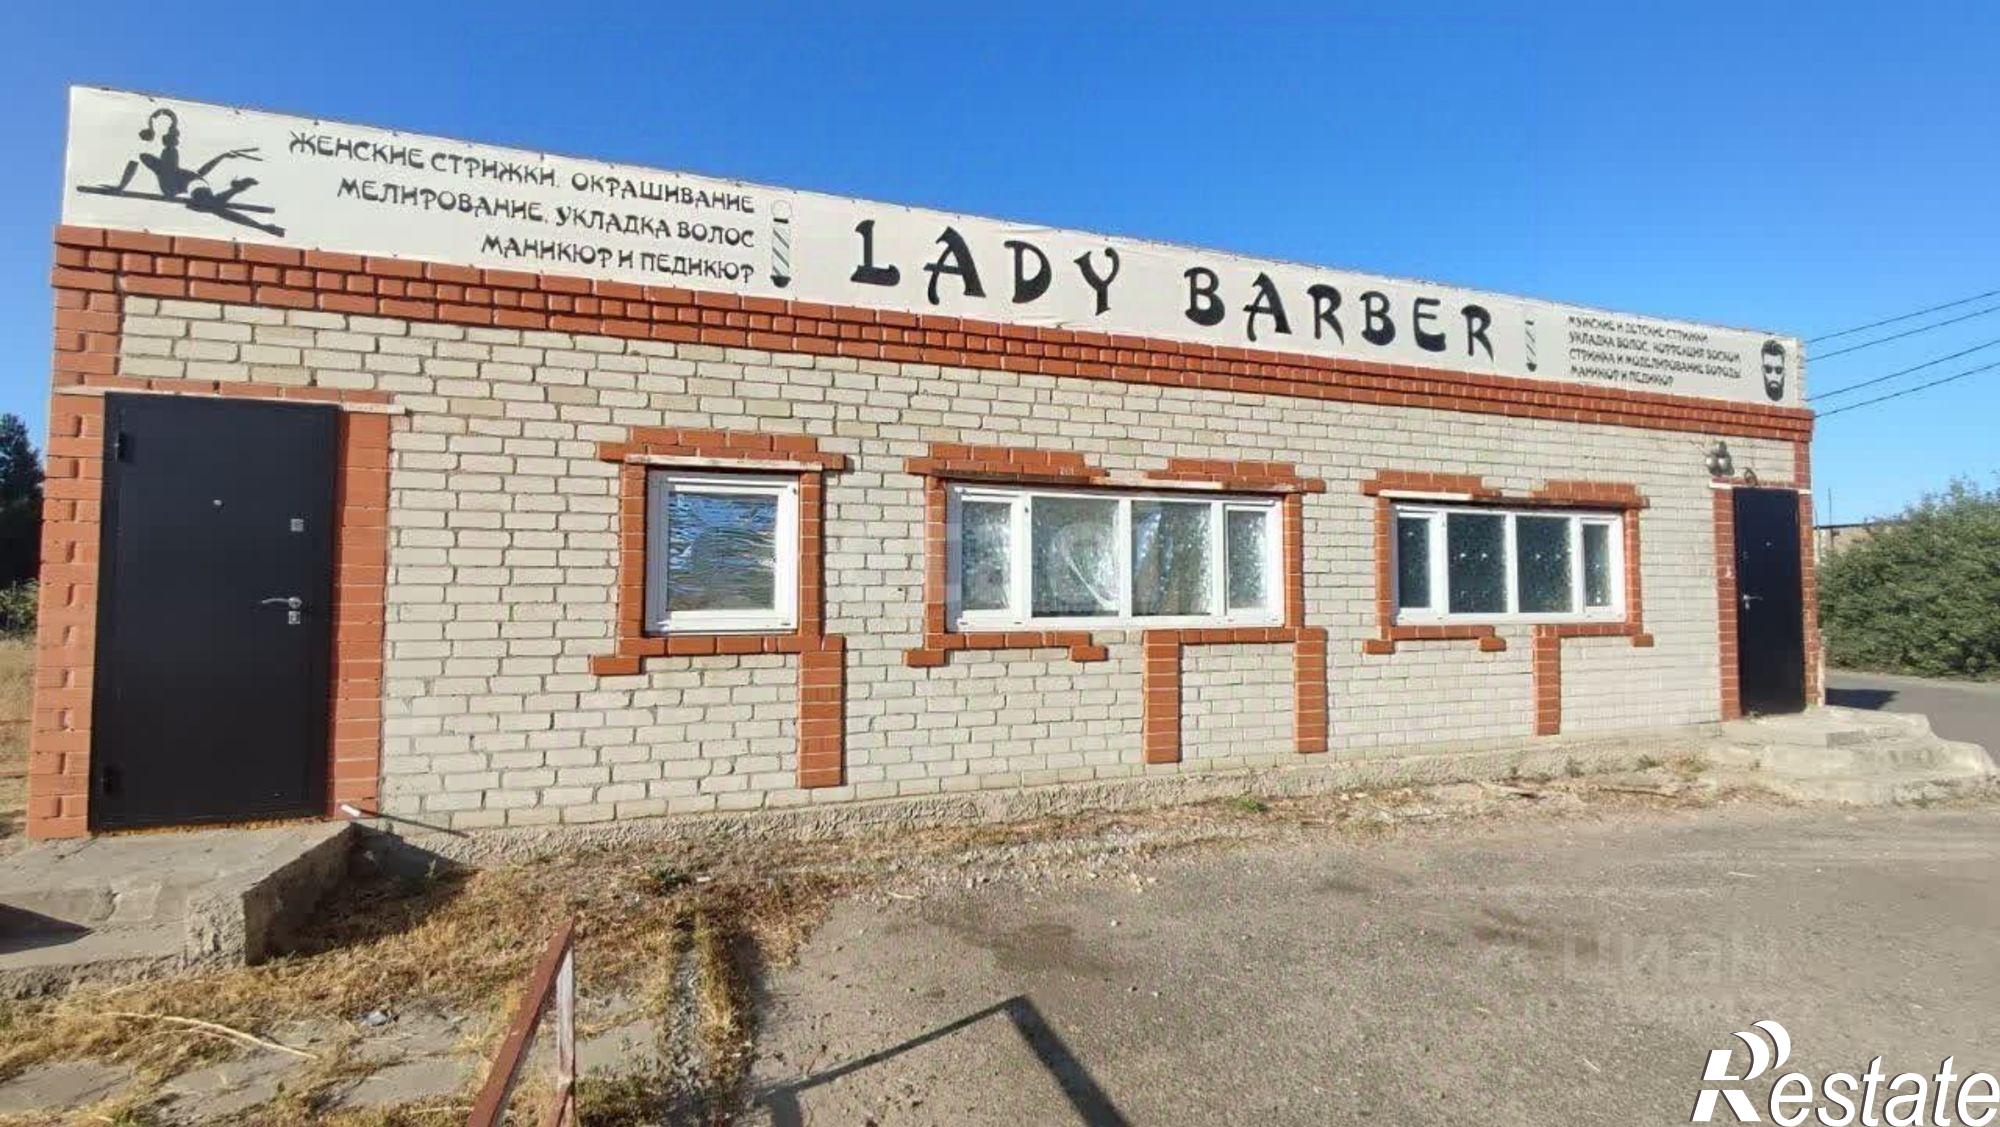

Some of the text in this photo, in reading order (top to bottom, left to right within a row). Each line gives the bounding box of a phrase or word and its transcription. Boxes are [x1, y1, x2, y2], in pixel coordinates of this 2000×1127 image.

[288, 130, 425, 170] ЖЕНСКИЕ
[570, 172, 756, 214] ОКРАШИВАНИЕ
[481, 235, 755, 285] МАНИКЮР И ПЕДИКЮР
[555, 206, 672, 240] УКЛАДКА
[677, 220, 755, 249] ВОЛОС
[850, 219, 1495, 361] LADY BARBER
